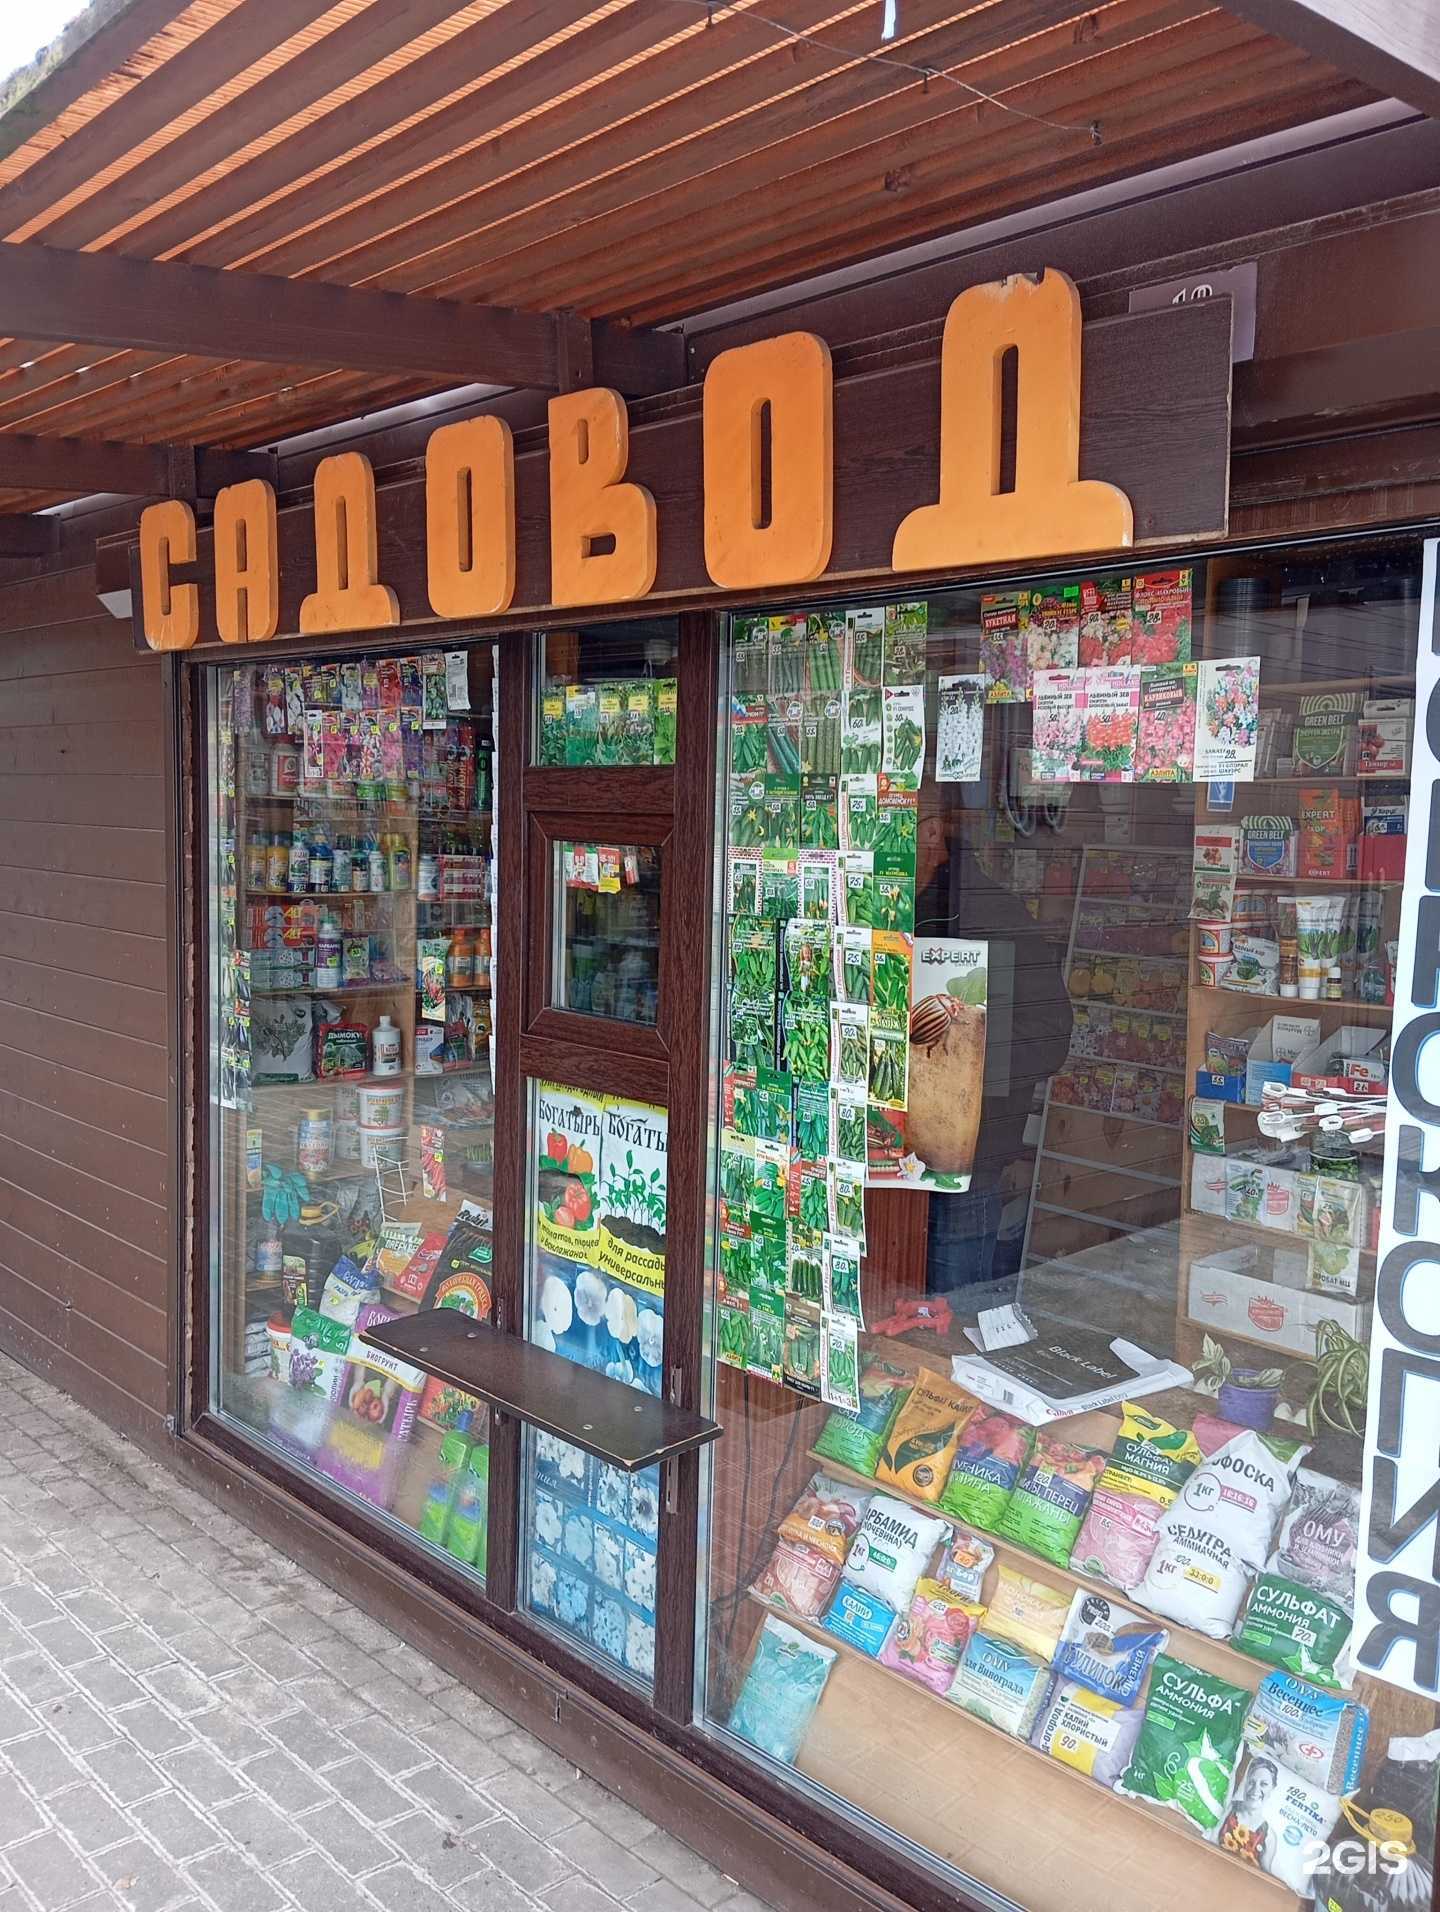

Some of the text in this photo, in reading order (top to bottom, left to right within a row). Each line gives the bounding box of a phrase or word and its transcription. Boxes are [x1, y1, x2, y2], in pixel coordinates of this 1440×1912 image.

[140, 267, 1134, 652] САДОВОД
[1304, 713, 1346, 727] GREEN BELT
[1302, 808, 1336, 820] EXPERT
[1247, 828, 1285, 841] GREEN BELT
[921, 947, 981, 966] EXPERT
[1350, 1063, 1369, 1078] Fe
[539, 1098, 600, 1137] БОГАТЫРЬ
[607, 1237, 625, 1257] для
[366, 1350, 399, 1372] БИОГРУНТ
[1049, 1345, 1118, 1379] Black Label
[1124, 1452, 1170, 1475] МАГНИЯ
[1043, 1489, 1080, 1515] ПЕРЕЦ
[1167, 1523, 1232, 1558] СЕЛИТРА
[1303, 1520, 1347, 1547] ОМУ
[1173, 1536, 1230, 1571] АММИАЧНАЯ
[1251, 1603, 1311, 1629] АММОНИЯ
[1257, 1586, 1341, 1629] СУЛЬФАТ
[977, 1664, 1024, 1696] Винограда
[1121, 1649, 1146, 1697] СЛИЗНЕЙ
[1155, 1685, 1216, 1720] АММОНИЯ
[1060, 1719, 1109, 1748] ХЛОРИСТЫЙ
[1063, 1712, 1090, 1729] КАЛИЙ
